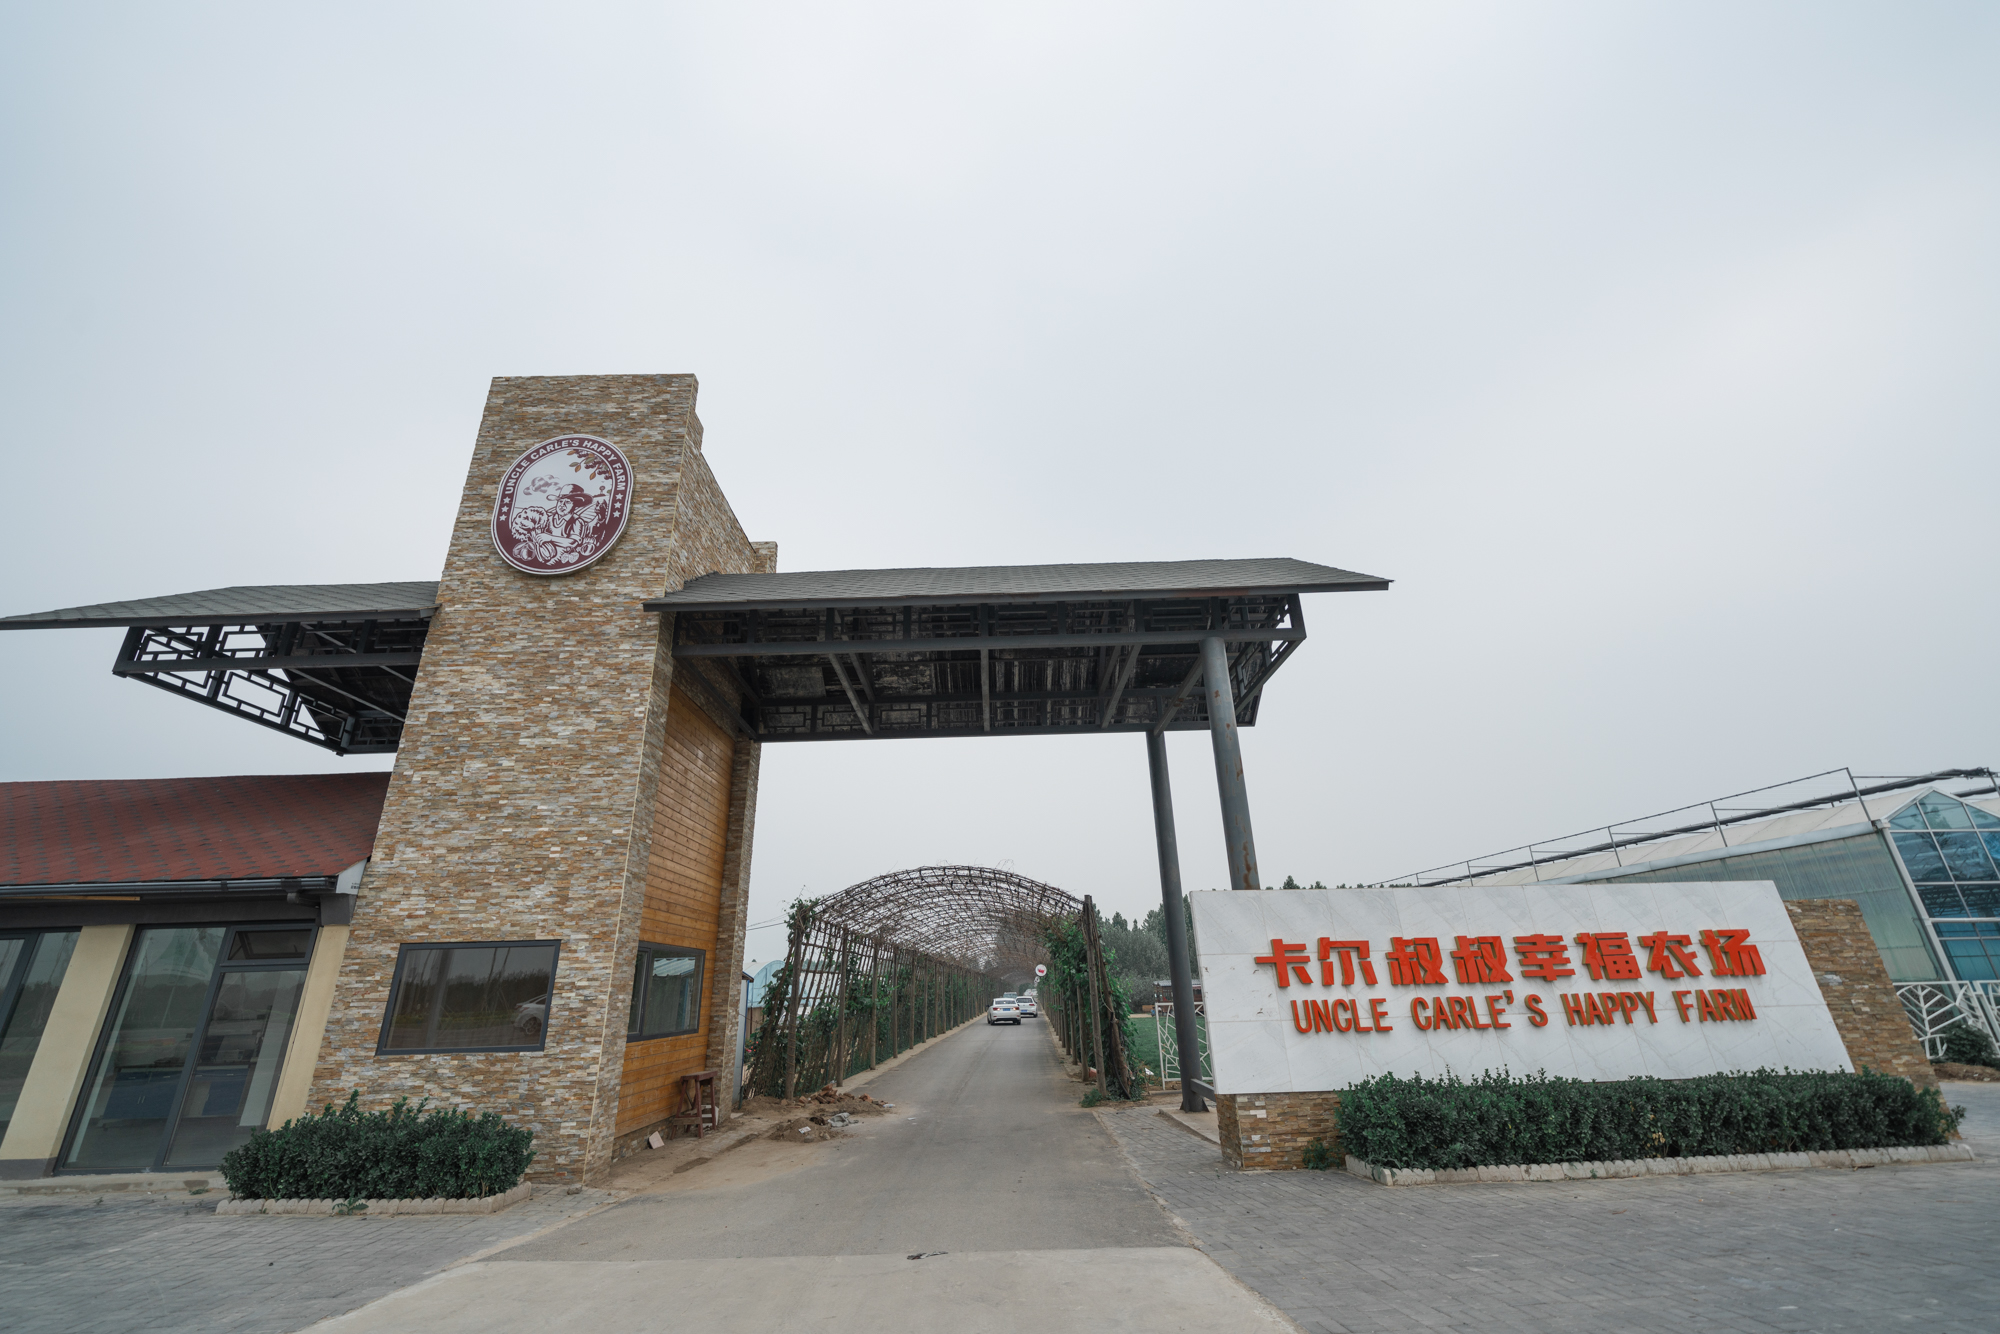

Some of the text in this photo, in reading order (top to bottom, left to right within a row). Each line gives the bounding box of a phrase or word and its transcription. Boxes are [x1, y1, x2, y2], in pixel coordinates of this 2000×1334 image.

[505, 439, 626, 494] UNCLE CARLE'S HAPPY FARM
[1254, 928, 1767, 988] 卡尔叔叔幸福农场
[1290, 997, 1394, 1033] UNCLE
[1559, 990, 1658, 1027] HAPPY
[1671, 988, 1758, 1024] FARM
